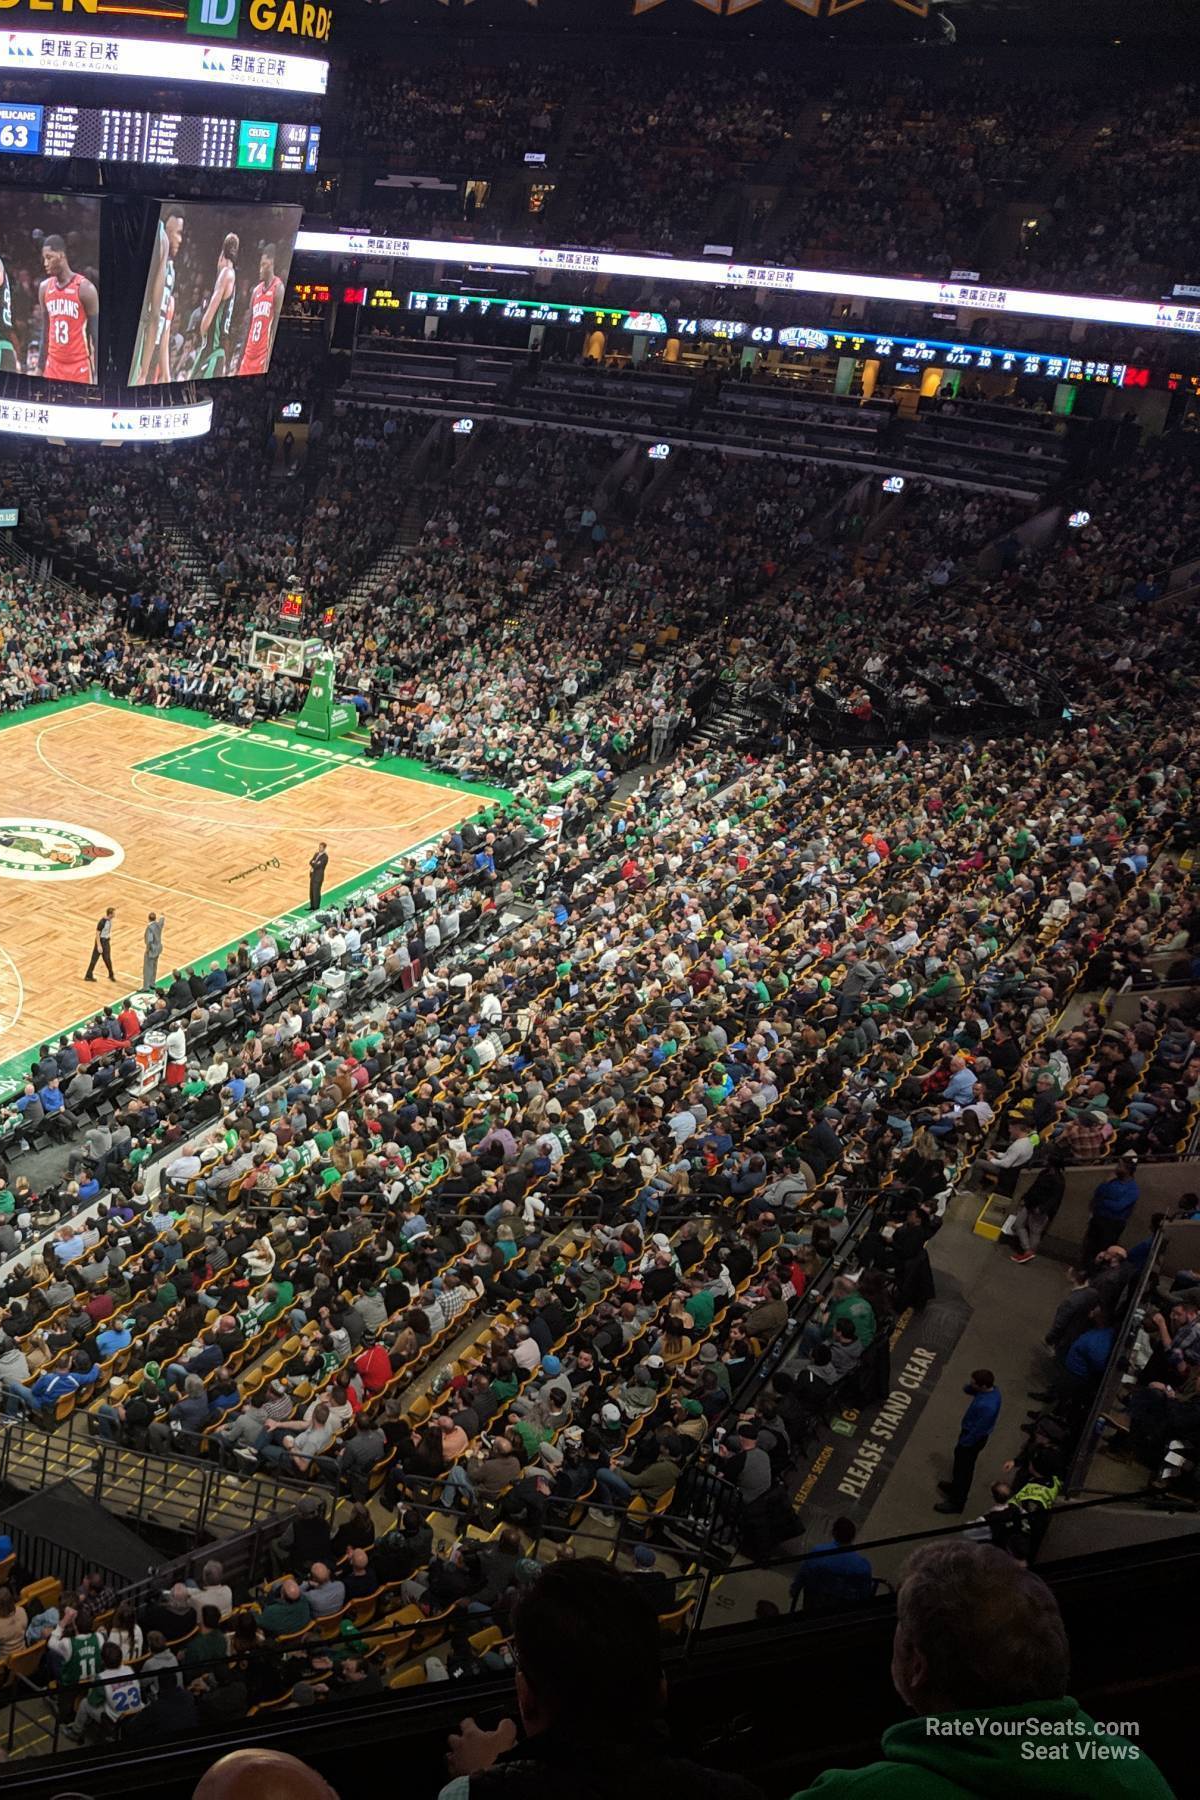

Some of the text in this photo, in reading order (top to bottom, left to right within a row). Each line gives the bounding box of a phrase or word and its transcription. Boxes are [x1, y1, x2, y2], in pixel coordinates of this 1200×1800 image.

[41, 39, 119, 60] 奥瑞金包装
[231, 54, 287, 76] 奥瑞金包装
[0, 125, 28, 148] 63
[248, 142, 267, 163] 74
[746, 268, 794, 283] 奥瑞金包装
[958, 288, 1006, 302] 奥瑞金包装
[415, 300, 426, 309] 36
[460, 304, 466, 313] 7
[481, 306, 487, 315] 7
[531, 310, 558, 320] 30/65
[569, 314, 581, 323] 46
[55, 320, 69, 345] 13
[677, 319, 696, 334] 74
[713, 321, 742, 334] 4:16
[751, 327, 773, 342] 63
[875, 346, 890, 355] 44
[902, 348, 936, 359] 25/57
[946, 354, 971, 364] 6/17
[978, 357, 991, 366] 10
[1003, 361, 1011, 369] 6
[1024, 363, 1038, 373] 19
[1046, 366, 1060, 376] 27
[876, 338, 893, 346] FG%
[1003, 353, 1016, 361] STL
[1025, 356, 1040, 364] AST
[1124, 367, 1149, 388] 24
[289, 402, 302, 414] 10
[138, 413, 190, 429] 奥瑞金包装
[461, 418, 473, 430] 10
[657, 444, 670, 456] 10
[891, 476, 904, 489] 10
[1078, 511, 1090, 523] 10
[283, 600, 300, 615] 24
[247, 733, 377, 767] GARDEN
[19, 825, 92, 847] BOSTON
[838, 1346, 937, 1499] PLEASE STAND CLEAR
[811, 1444, 834, 1474] SECTION
[112, 1686, 141, 1706] 23
